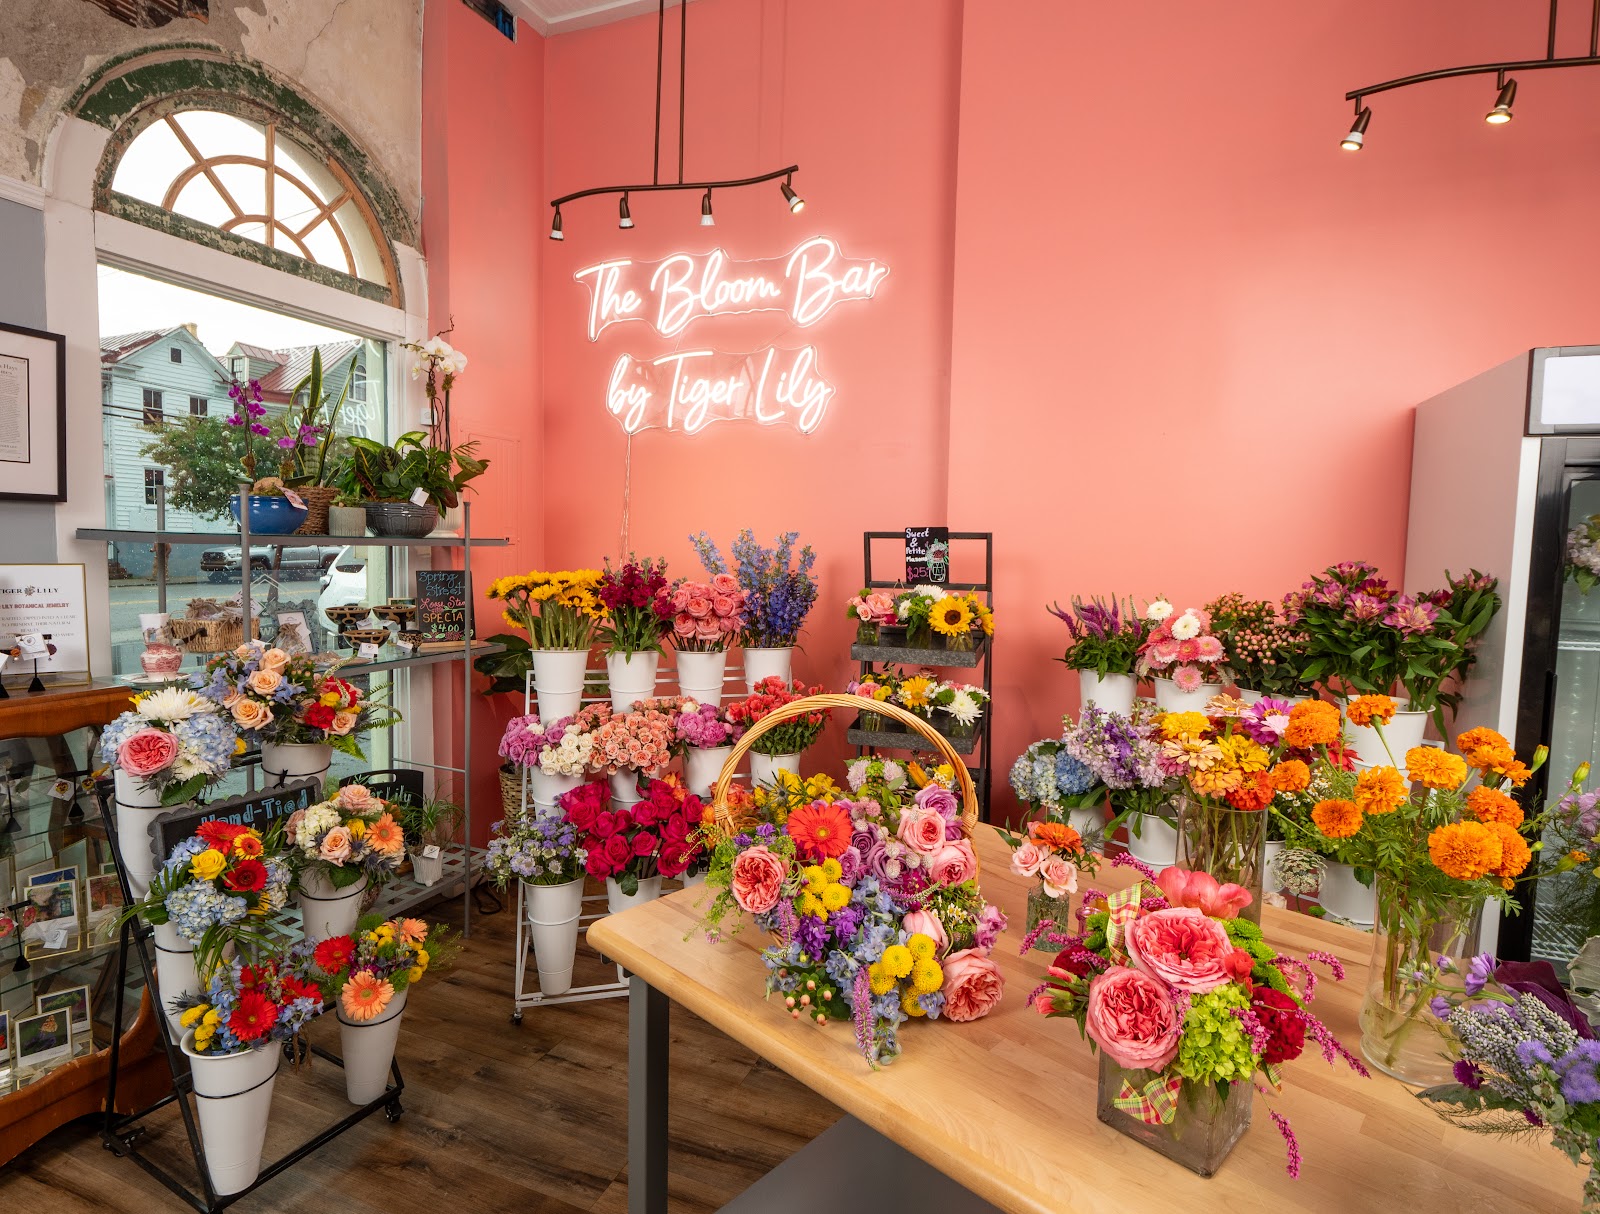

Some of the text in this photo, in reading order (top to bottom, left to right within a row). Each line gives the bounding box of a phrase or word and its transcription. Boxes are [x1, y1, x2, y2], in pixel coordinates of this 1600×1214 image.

[575, 237, 886, 339] The Bloom Bar
[607, 345, 832, 433] by Tiger Lily
[906, 528, 929, 538] Sweet
[909, 537, 918, 547] &
[905, 547, 926, 555] Petite
[419, 571, 459, 588] Spring
[425, 581, 466, 597] Street
[422, 612, 465, 623] SPECIA
[430, 623, 460, 633] $4.00
